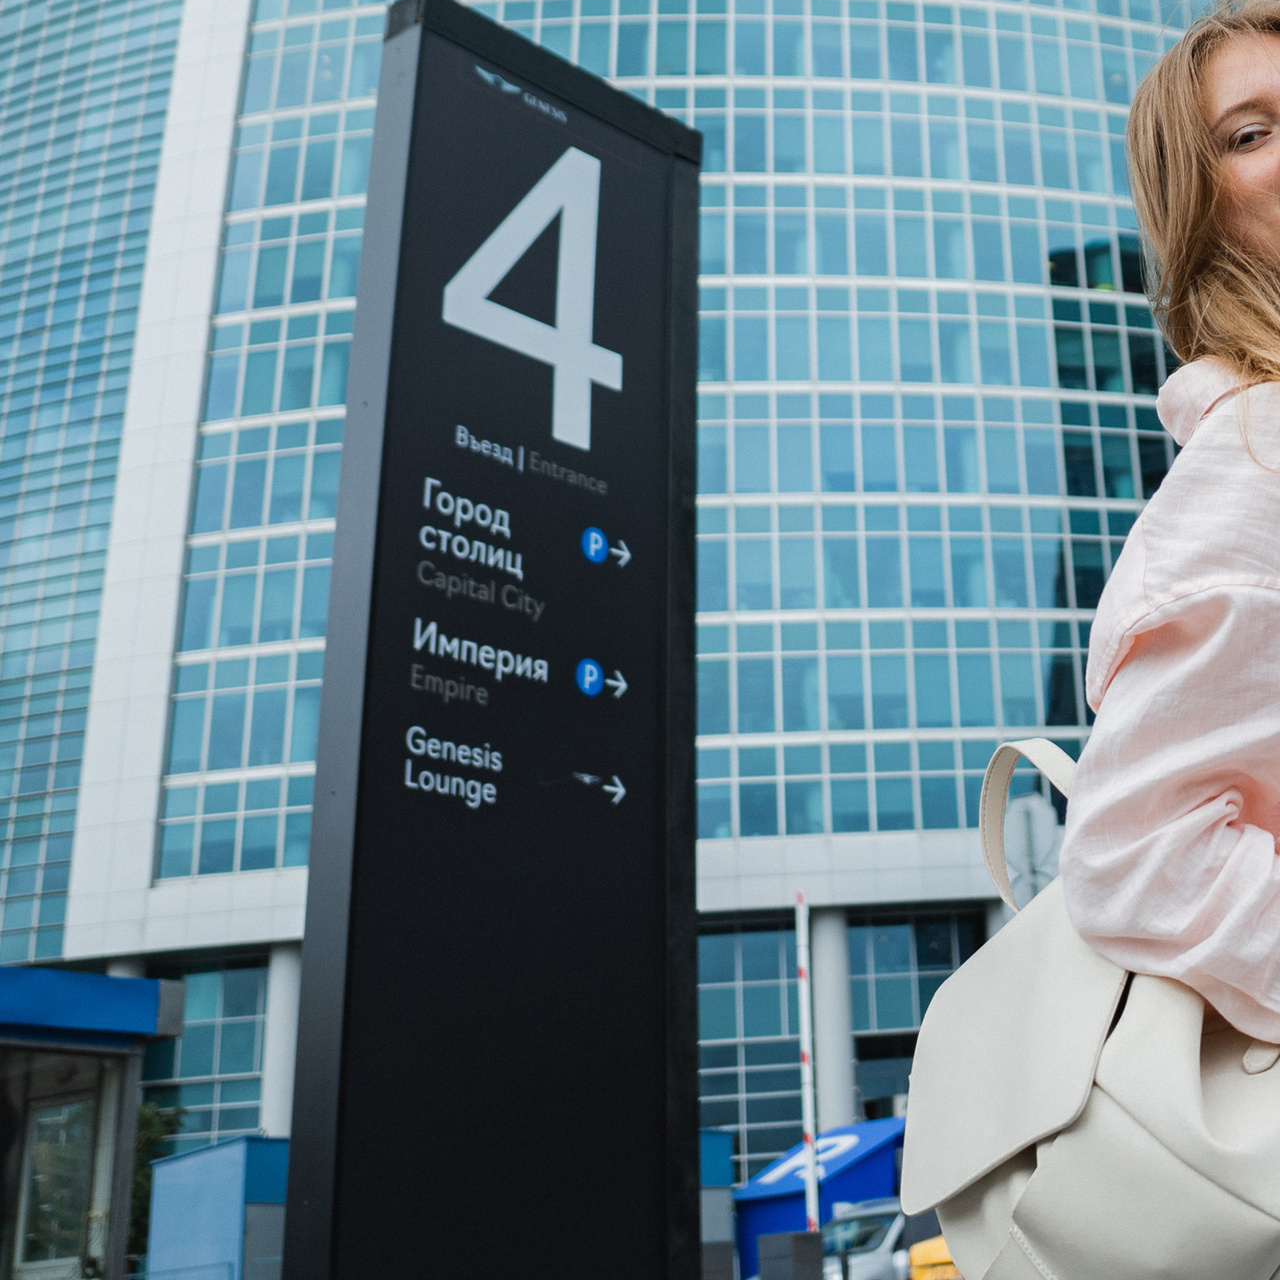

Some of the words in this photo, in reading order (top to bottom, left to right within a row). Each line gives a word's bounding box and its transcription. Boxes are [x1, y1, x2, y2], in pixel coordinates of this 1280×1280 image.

[442, 146, 623, 451] 4
[454, 424, 514, 466] Въезд
[529, 451, 608, 494] Entrance
[423, 477, 511, 538] Город
[419, 525, 524, 580] столиц
[417, 561, 495, 601] Capital
[503, 585, 546, 621] City
[413, 617, 549, 683] Империя
[410, 665, 489, 705] Empire
[406, 726, 502, 771] Genesis
[405, 760, 497, 809] Lounge
